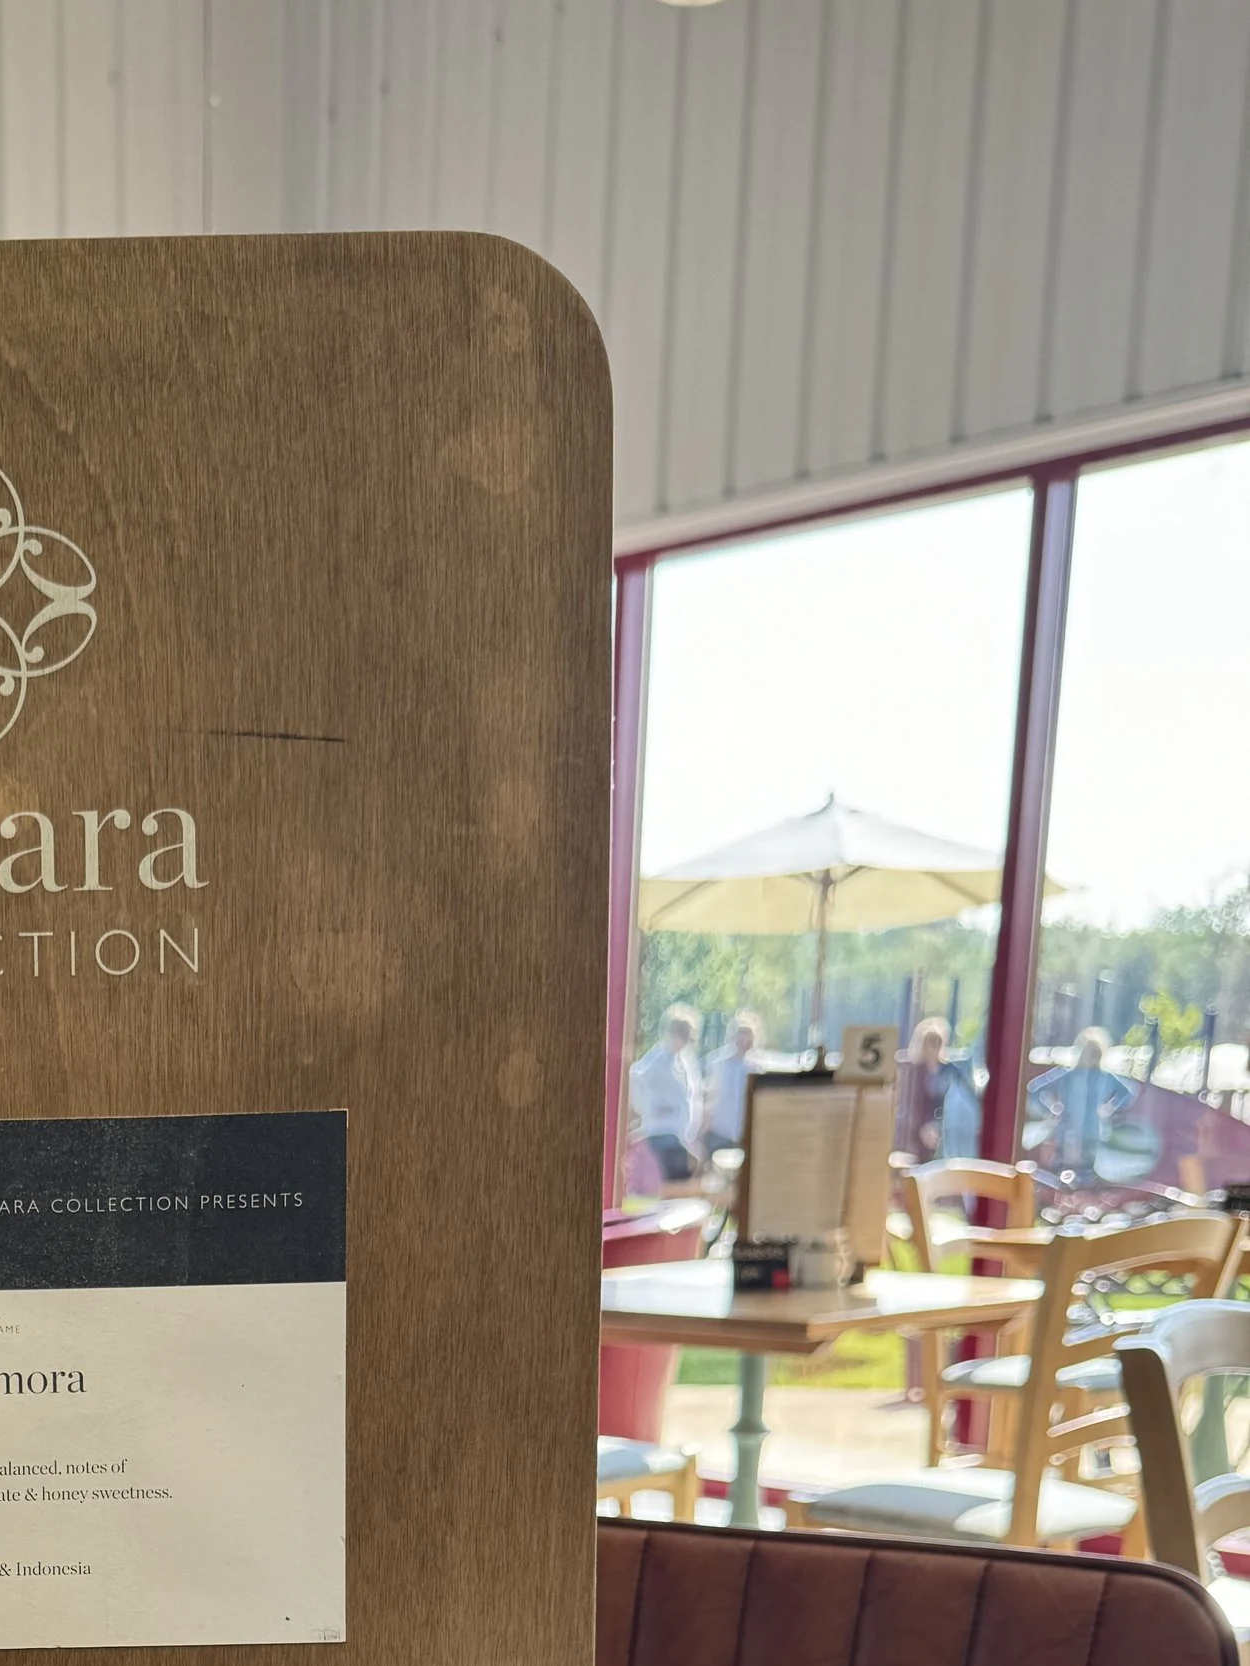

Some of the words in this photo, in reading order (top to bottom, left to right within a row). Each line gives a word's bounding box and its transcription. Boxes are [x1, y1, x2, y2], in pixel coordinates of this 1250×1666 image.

[858, 1032, 883, 1069] 5
[50, 1195, 189, 1213] COLLECTION
[200, 1192, 303, 1210] PRESENTS
[66, 1461, 108, 1475] notes
[111, 1458, 128, 1474] of
[25, 1487, 39, 1502] &
[42, 1486, 88, 1504] honey
[91, 1485, 173, 1500] sweetness.
[16, 1561, 92, 1577] Indonesia
